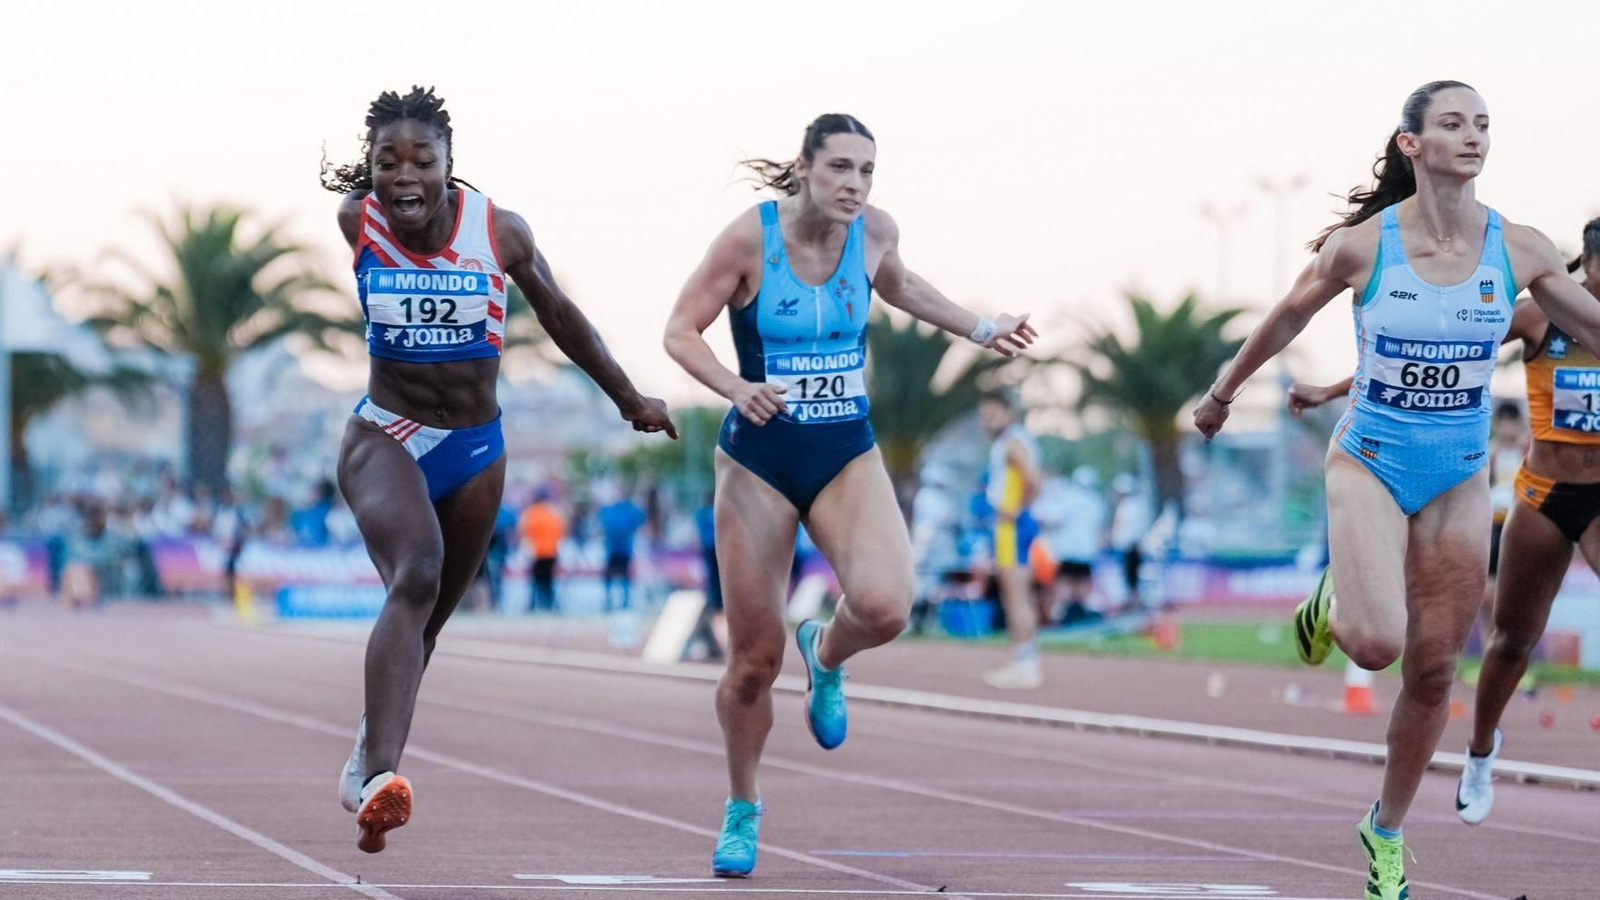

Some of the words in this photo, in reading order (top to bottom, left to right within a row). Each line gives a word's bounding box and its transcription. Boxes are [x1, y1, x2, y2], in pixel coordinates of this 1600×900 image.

[395, 273, 478, 292] MONDO
[1389, 290, 1419, 301] 42K
[399, 297, 459, 324] 192
[1400, 342, 1484, 360] MONDO
[791, 352, 859, 371] MONDO
[1400, 362, 1460, 389] 680
[796, 375, 845, 399] 120
